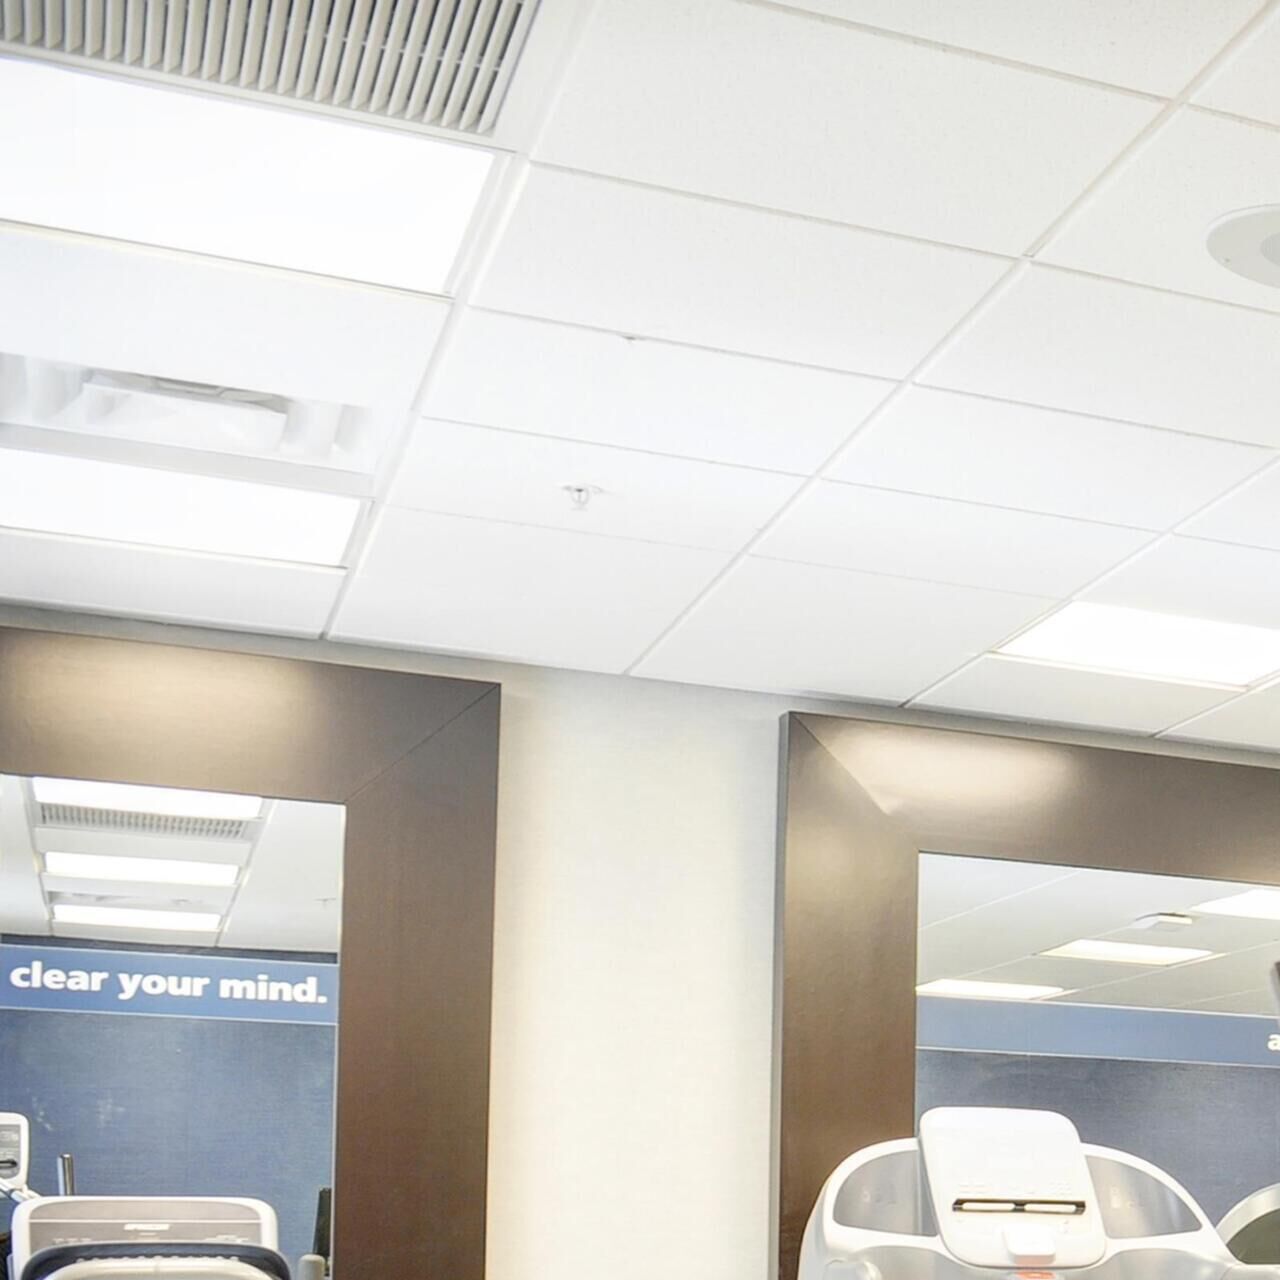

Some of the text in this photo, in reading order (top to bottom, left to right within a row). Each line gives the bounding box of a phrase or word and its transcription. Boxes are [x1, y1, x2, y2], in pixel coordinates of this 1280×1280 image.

[10, 961, 328, 1003] clear your mind.
